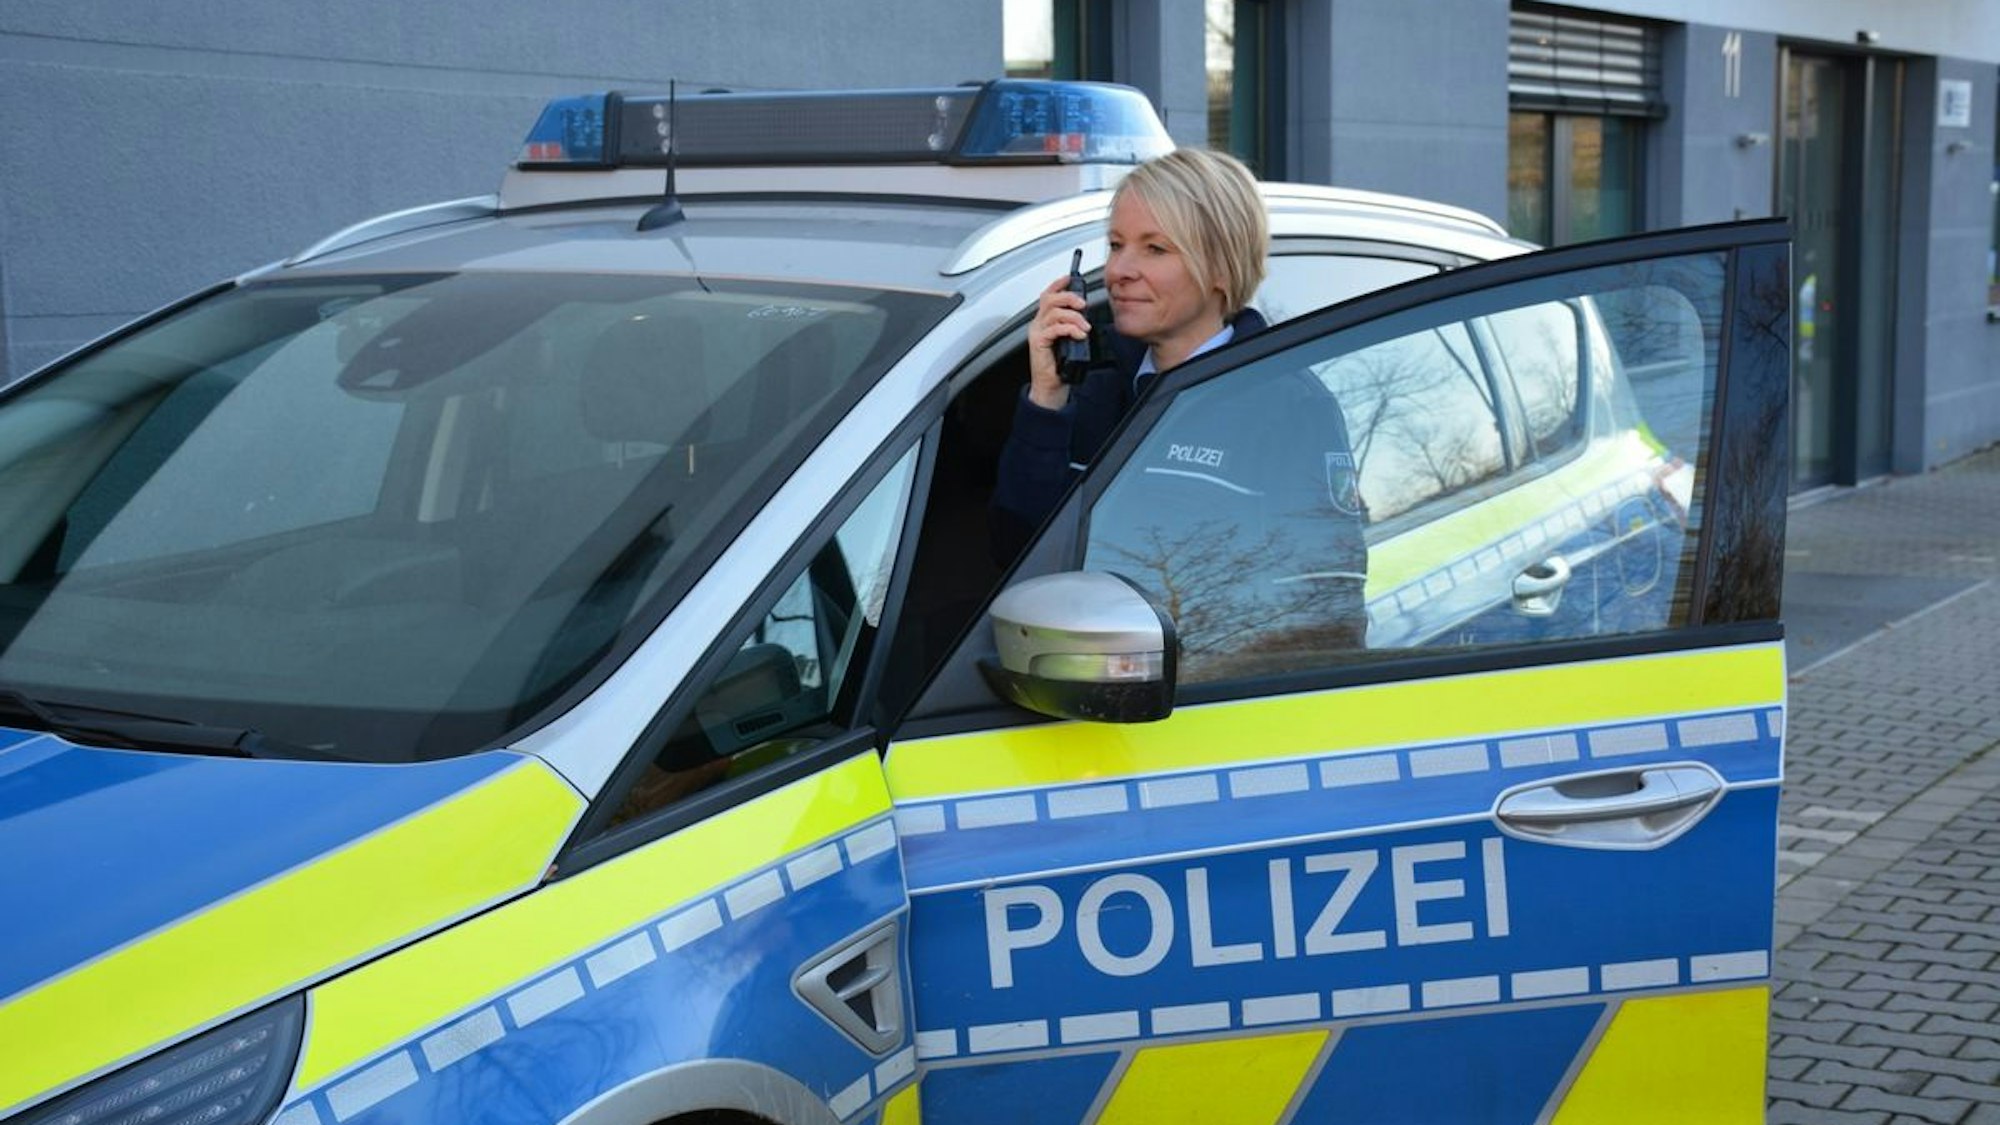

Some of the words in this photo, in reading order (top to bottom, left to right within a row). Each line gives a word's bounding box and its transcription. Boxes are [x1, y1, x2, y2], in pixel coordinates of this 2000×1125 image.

[1721, 32, 1742, 97] 11
[1167, 444, 1224, 467] POLIZEI
[984, 837, 1510, 989] POLIZEI
